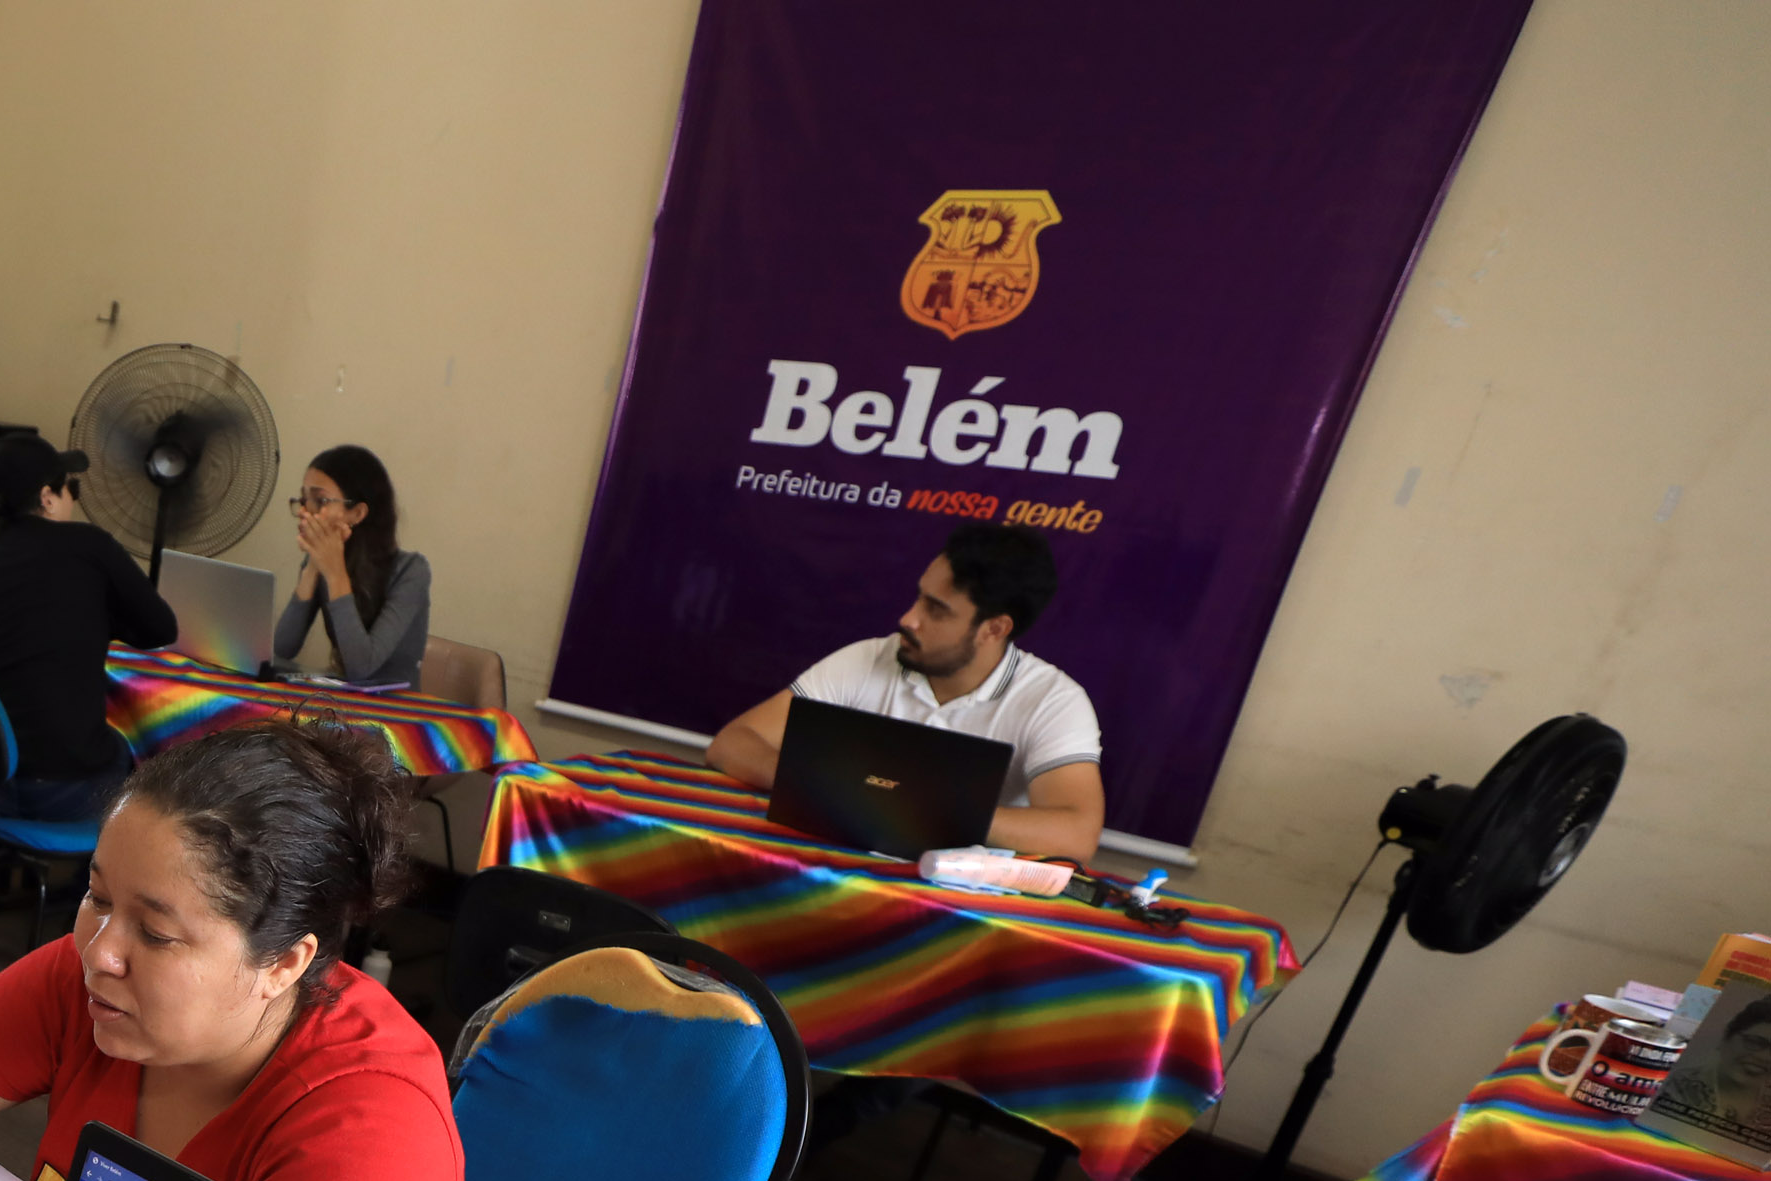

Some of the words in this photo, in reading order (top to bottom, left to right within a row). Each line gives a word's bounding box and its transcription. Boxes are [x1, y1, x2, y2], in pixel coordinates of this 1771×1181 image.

[749, 358, 1124, 480] Belém
[735, 464, 861, 504] Prefeitura
[866, 480, 902, 510] da
[906, 488, 999, 520] nossa
[1002, 498, 1104, 534] gente
[864, 773, 900, 791] acer
